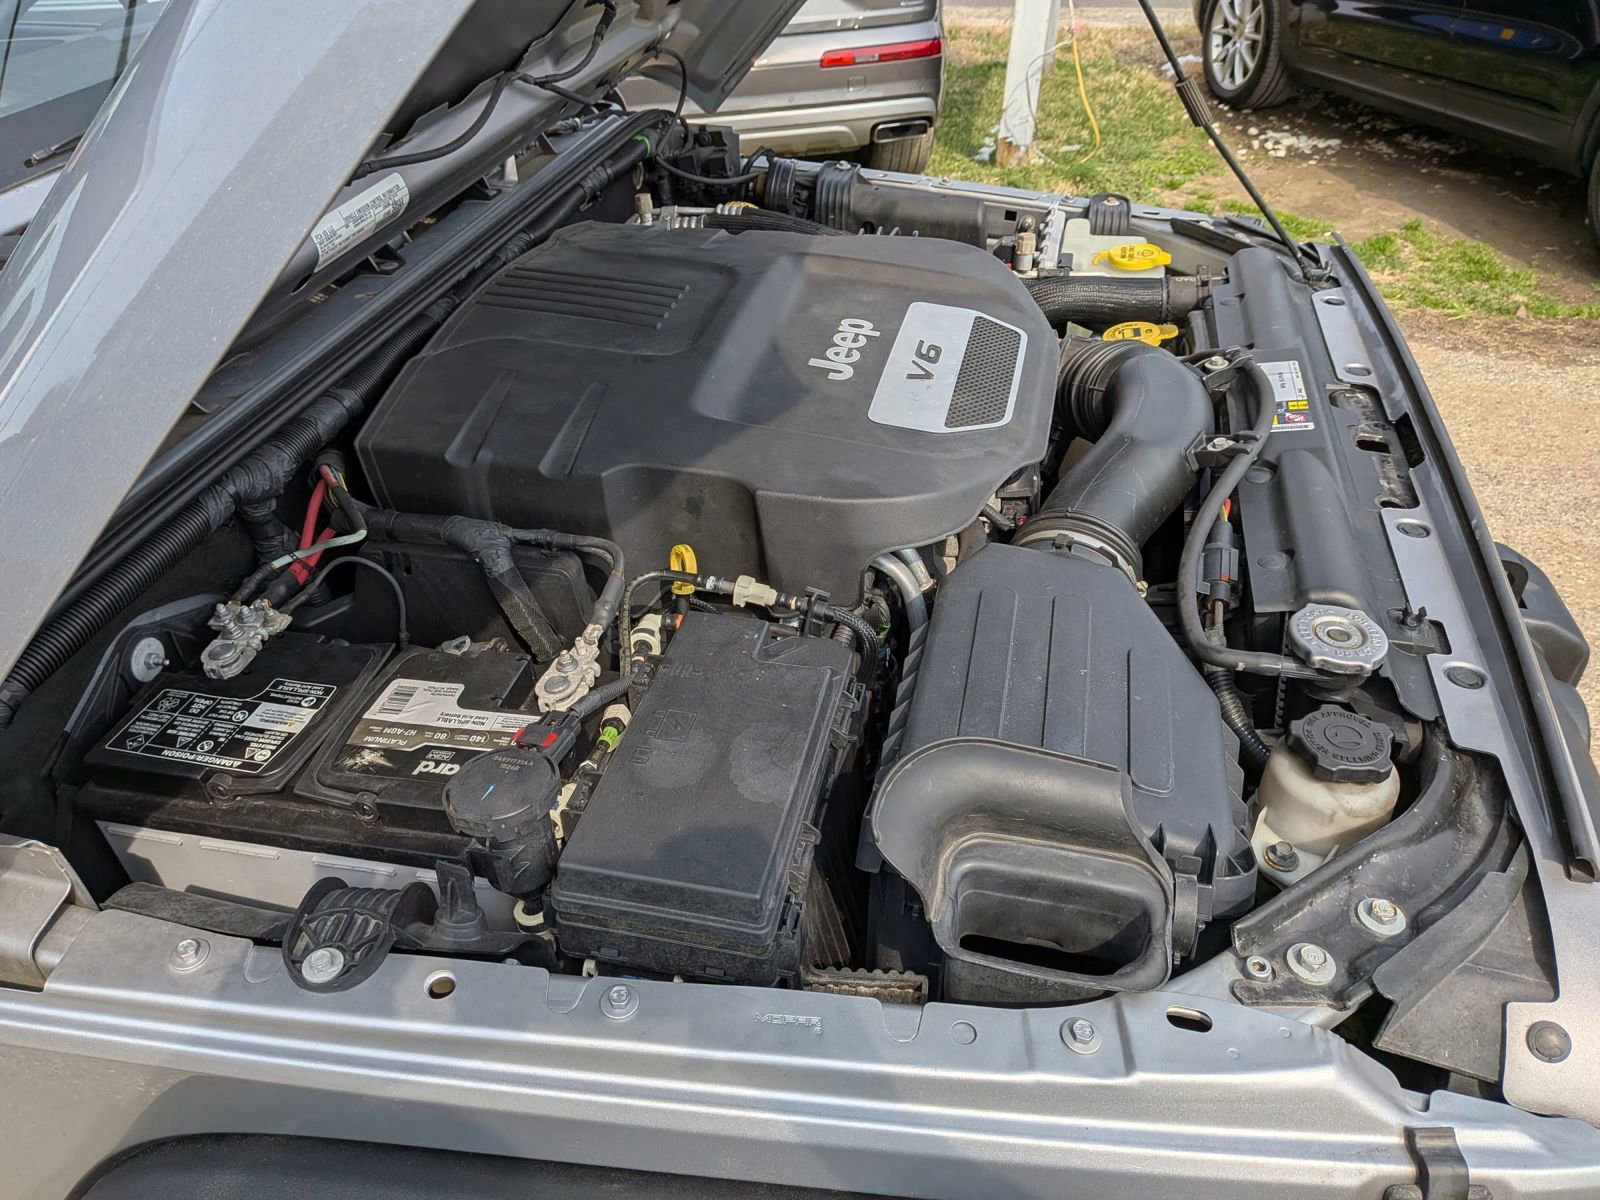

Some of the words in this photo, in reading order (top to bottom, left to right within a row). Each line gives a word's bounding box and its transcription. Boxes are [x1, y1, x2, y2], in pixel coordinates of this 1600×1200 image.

[808, 318, 880, 380] Jeep
[906, 340, 942, 380] V6
[364, 736, 407, 745] PLATINUM
[162, 750, 235, 766] DANGER/POISON
